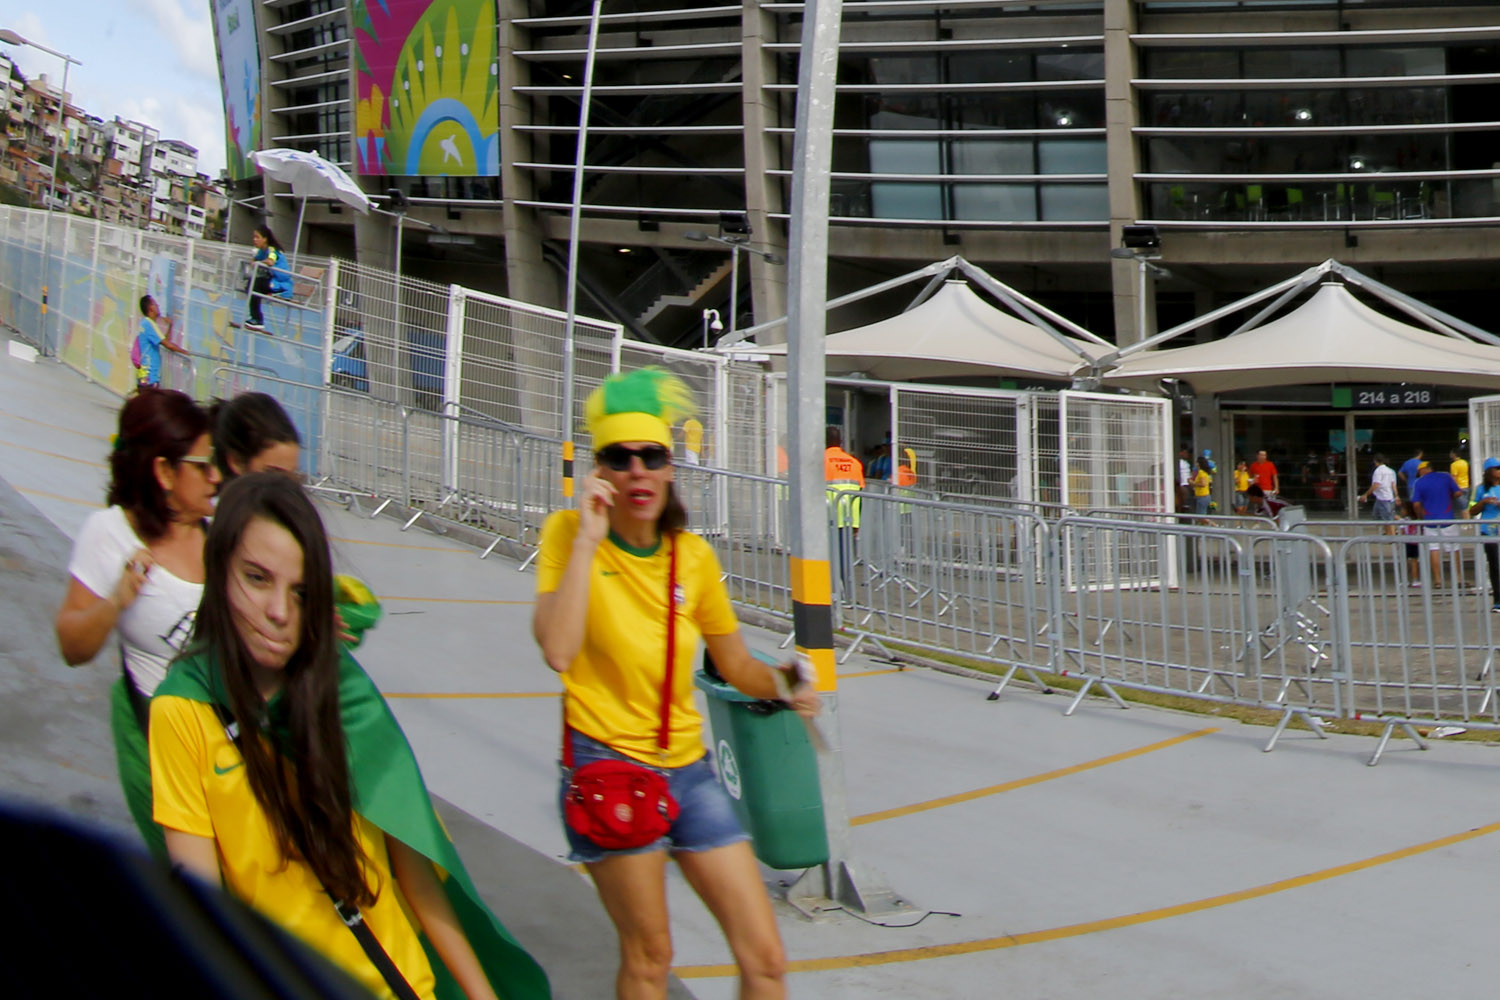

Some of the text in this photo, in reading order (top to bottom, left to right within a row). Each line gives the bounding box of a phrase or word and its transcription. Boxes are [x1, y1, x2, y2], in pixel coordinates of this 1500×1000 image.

[1359, 391, 1431, 404] 214 a 218
